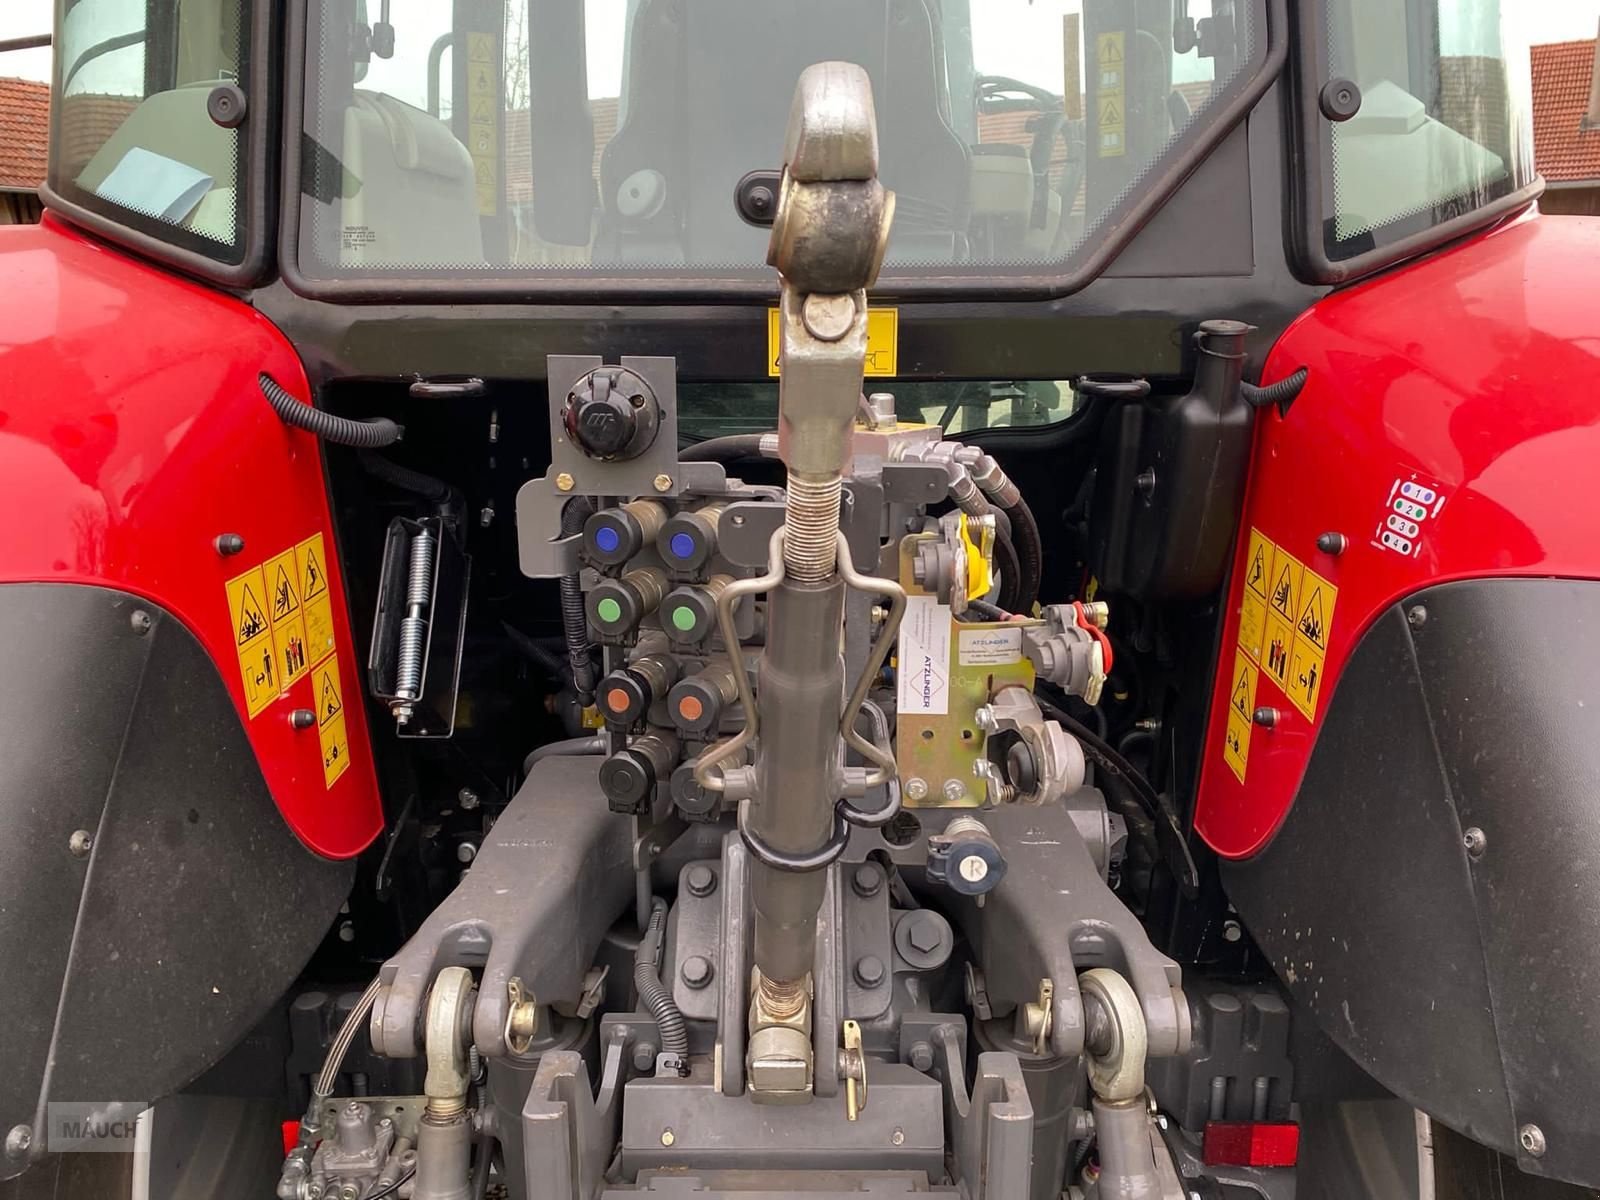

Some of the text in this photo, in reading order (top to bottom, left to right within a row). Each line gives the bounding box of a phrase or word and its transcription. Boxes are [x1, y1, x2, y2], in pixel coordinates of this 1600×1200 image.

[1415, 489, 1422, 498] 1
[1405, 505, 1413, 515] 2
[1399, 522, 1406, 531] 3
[1393, 539, 1399, 547] 4
[923, 655, 932, 708] ATZLINGER
[970, 859, 984, 878] R
